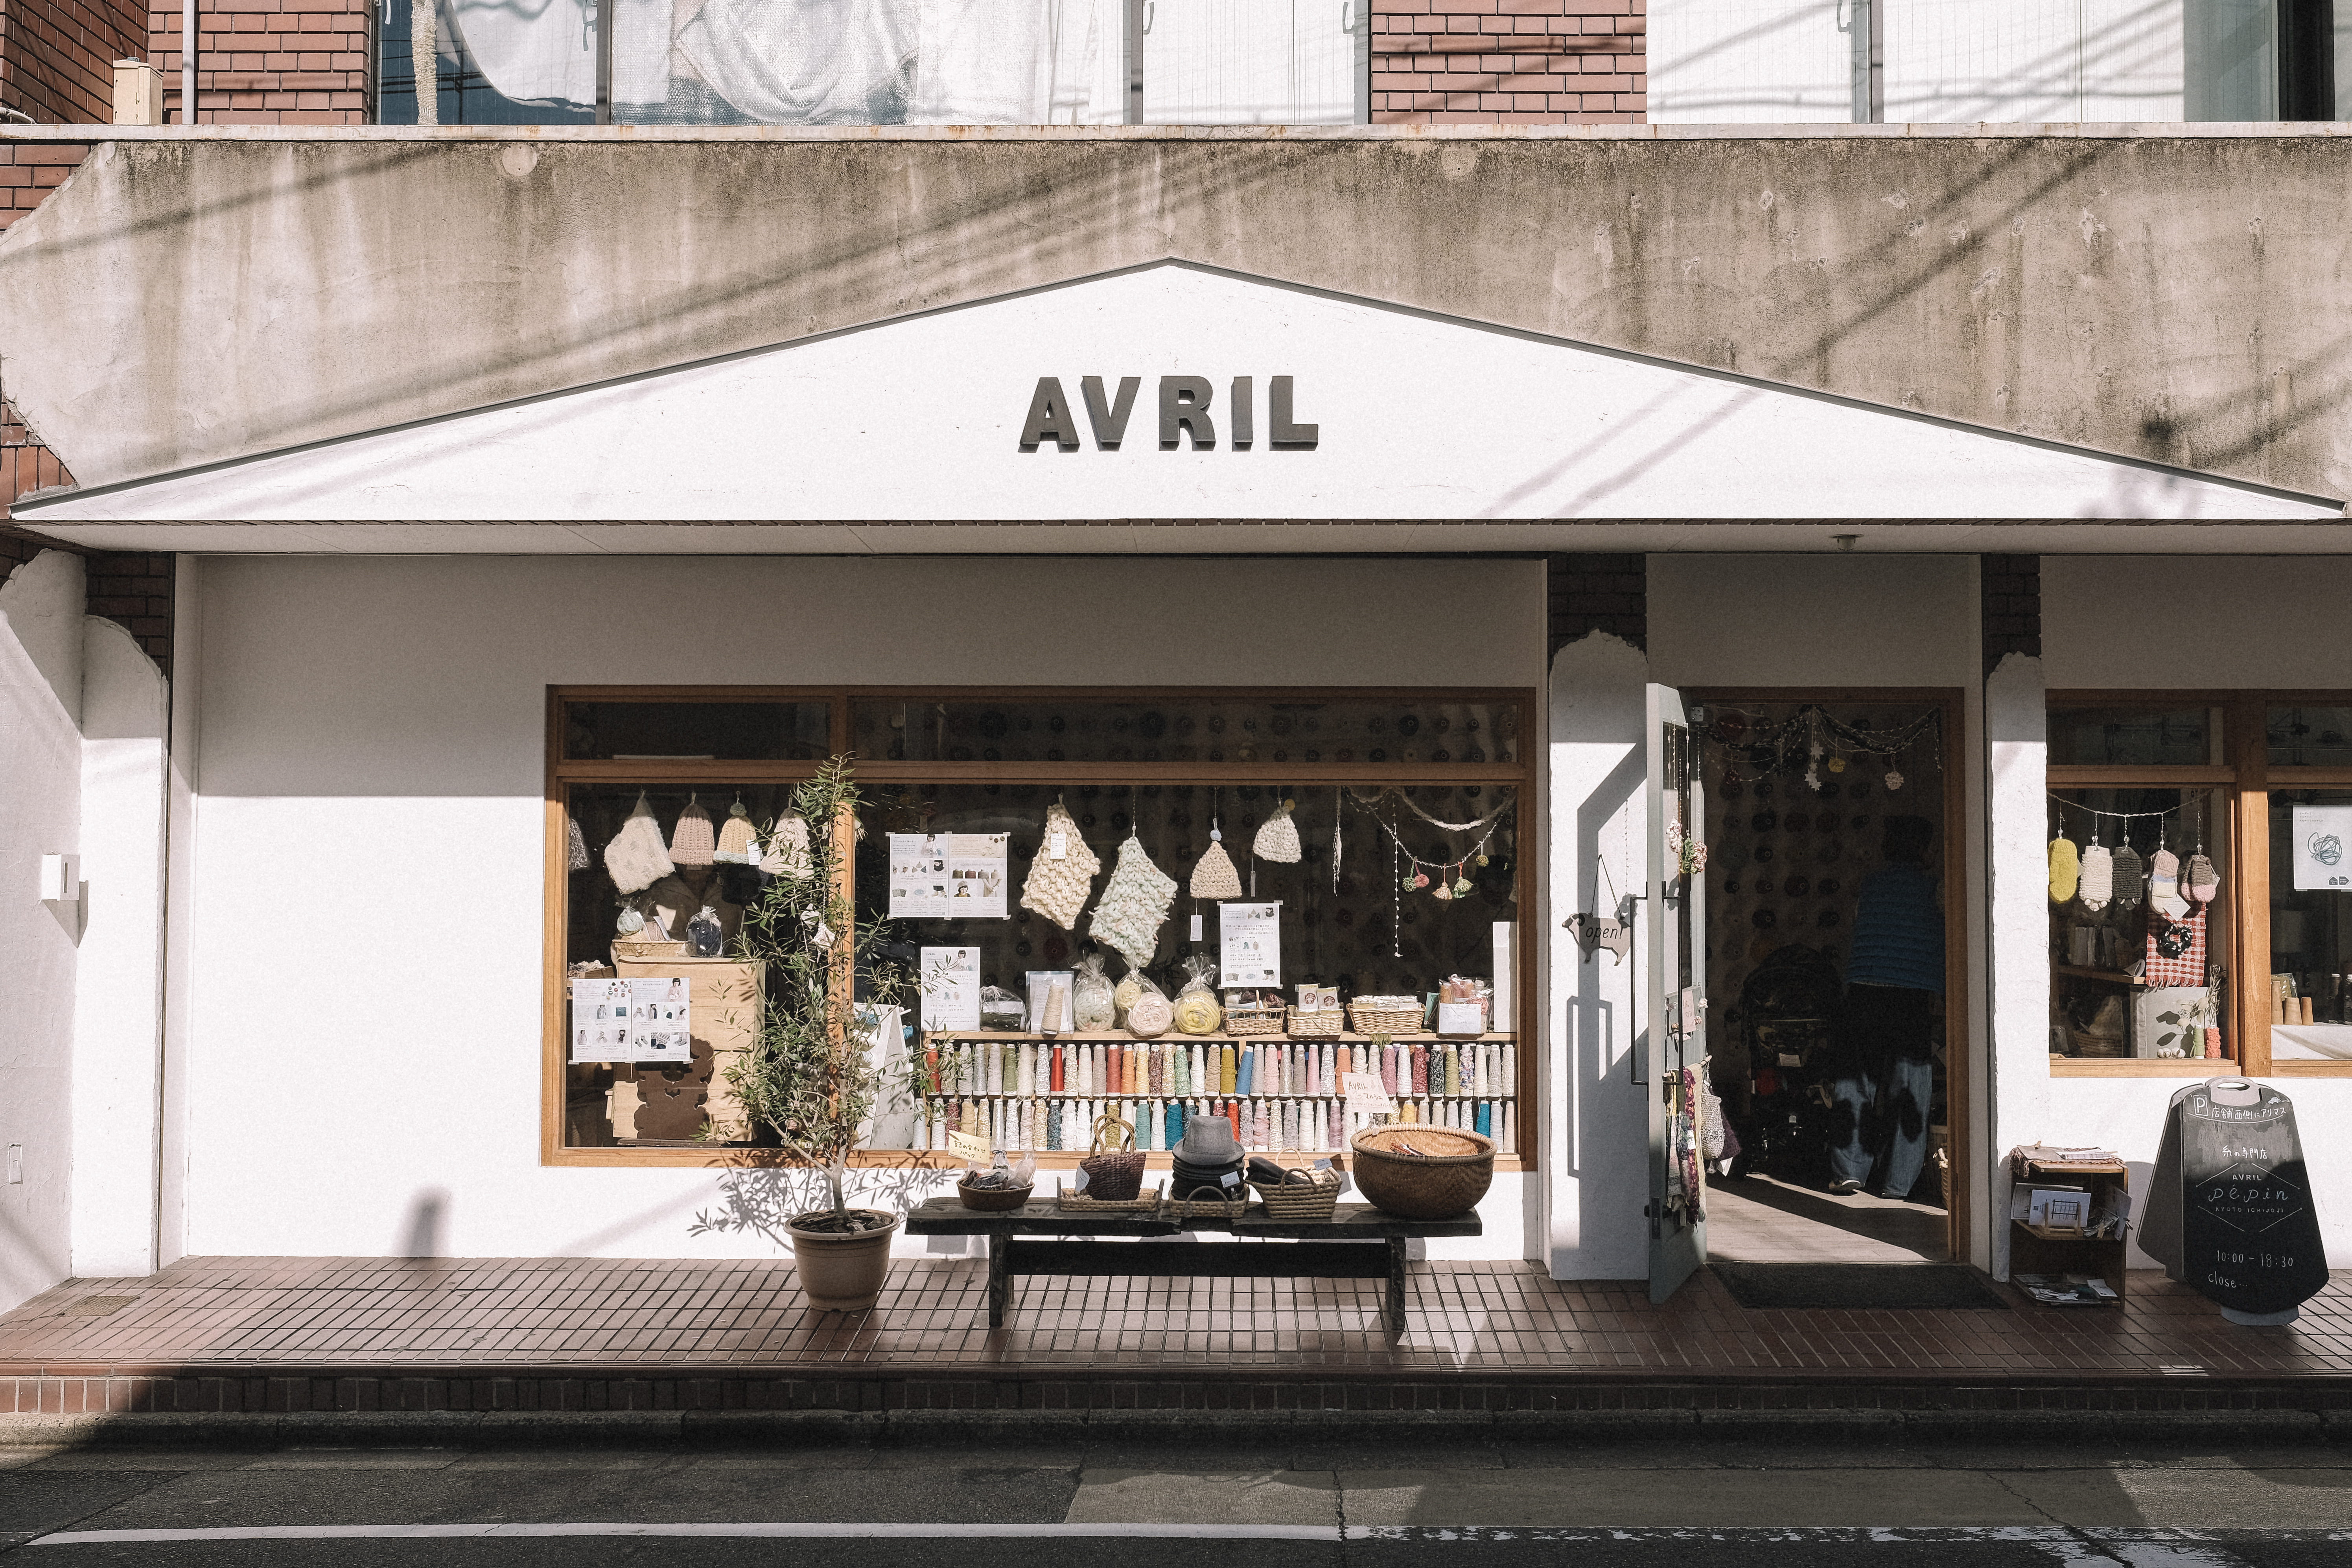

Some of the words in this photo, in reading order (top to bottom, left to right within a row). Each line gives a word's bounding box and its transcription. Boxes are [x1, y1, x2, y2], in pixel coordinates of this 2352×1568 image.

[1018, 375, 1319, 453] AVRIL
[1586, 926, 1623, 943] open!
[1348, 1081, 1368, 1090] AVRIL
[2196, 1097, 2205, 1113] P
[954, 1140, 985, 1153] 詰め合わせ
[2222, 1145, 2267, 1159] 糸の専門店
[2208, 1184, 2288, 1203] pépin
[2217, 1250, 2243, 1263] 10:00
[2261, 1253, 2293, 1268] 18:30
